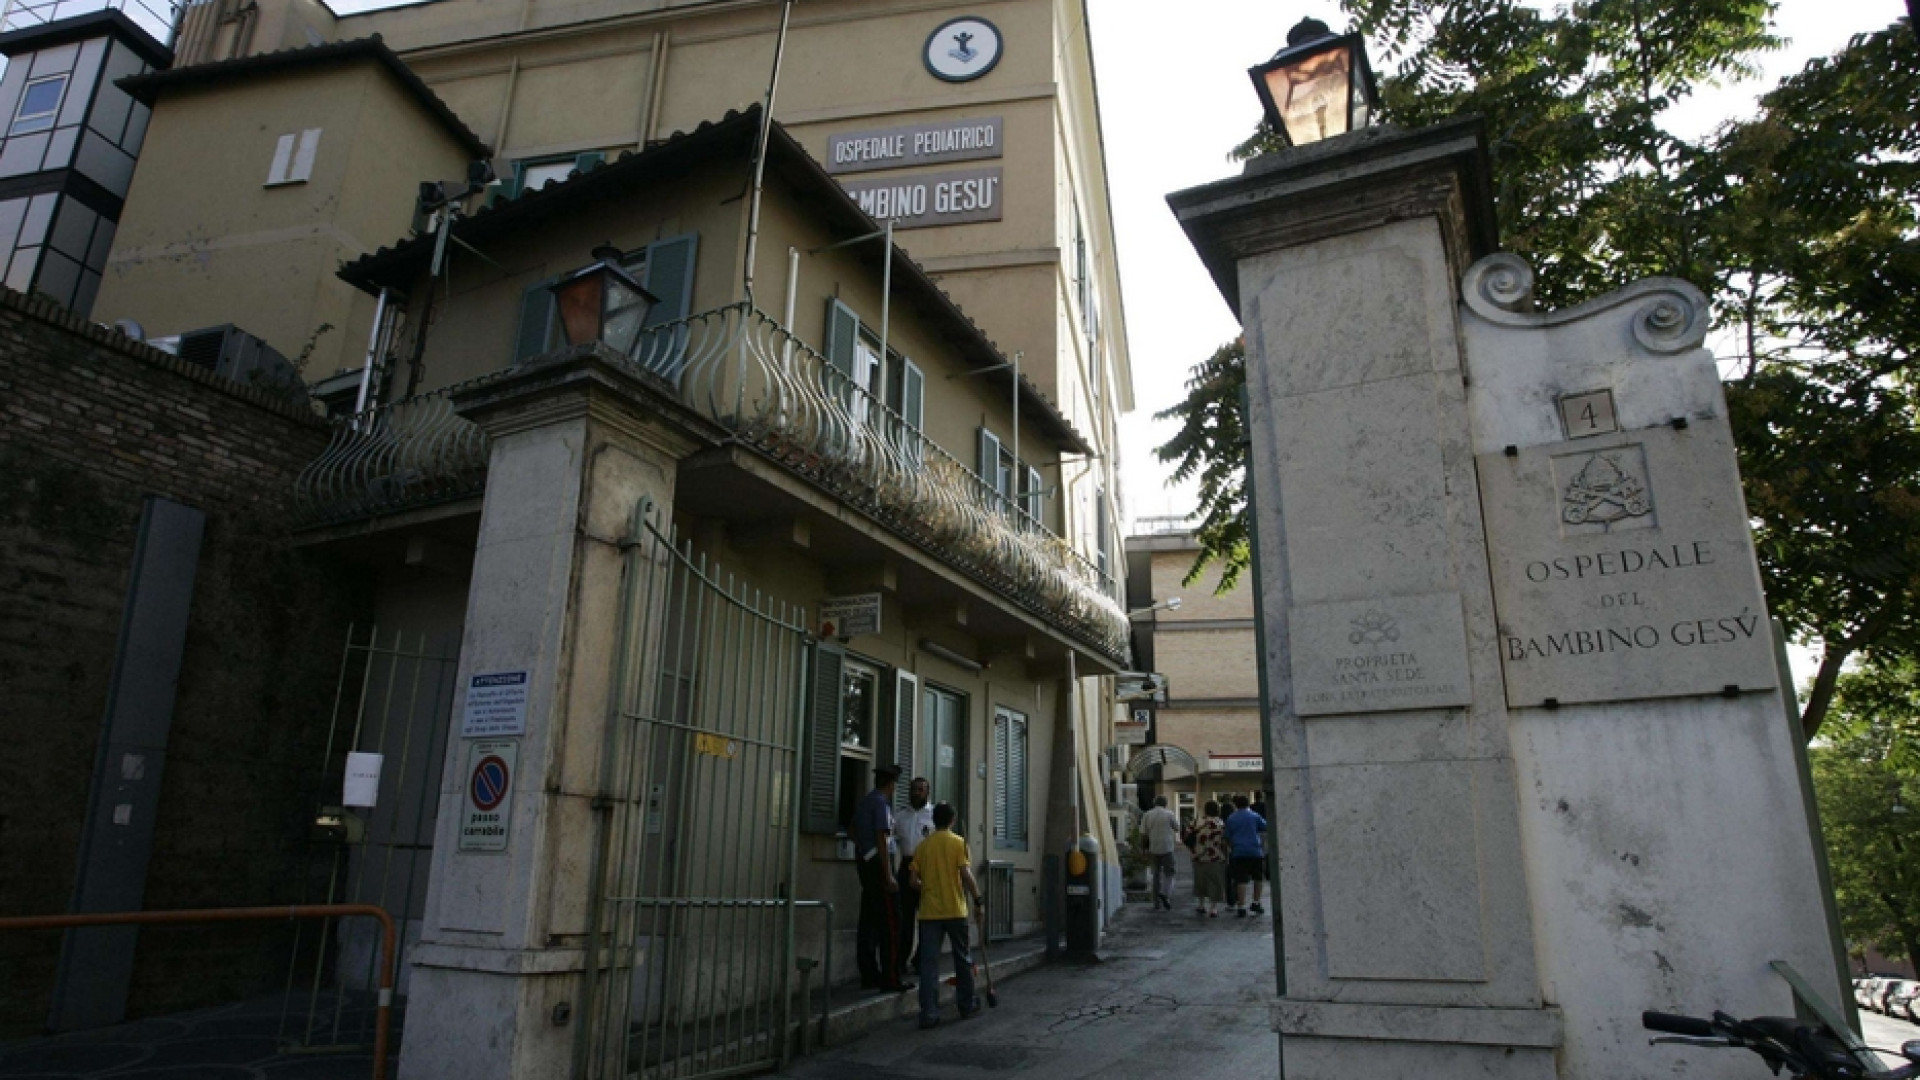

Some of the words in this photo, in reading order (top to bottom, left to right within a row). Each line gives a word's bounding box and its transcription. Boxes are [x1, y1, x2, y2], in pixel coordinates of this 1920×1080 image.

[836, 135, 904, 164] OSPEDALE
[914, 125, 994, 154] PEDIATRICO
[849, 185, 926, 218] MBINO
[1580, 403, 1598, 429] 4
[1526, 541, 1715, 583] OSPEDALE
[1600, 592, 1645, 608] DEL
[1507, 624, 1660, 661] BAMBINO
[1332, 672, 1379, 686] SANTA
[1387, 667, 1426, 682] SEDE
[464, 825, 505, 836] carrabile
[471, 814, 500, 825] passo
